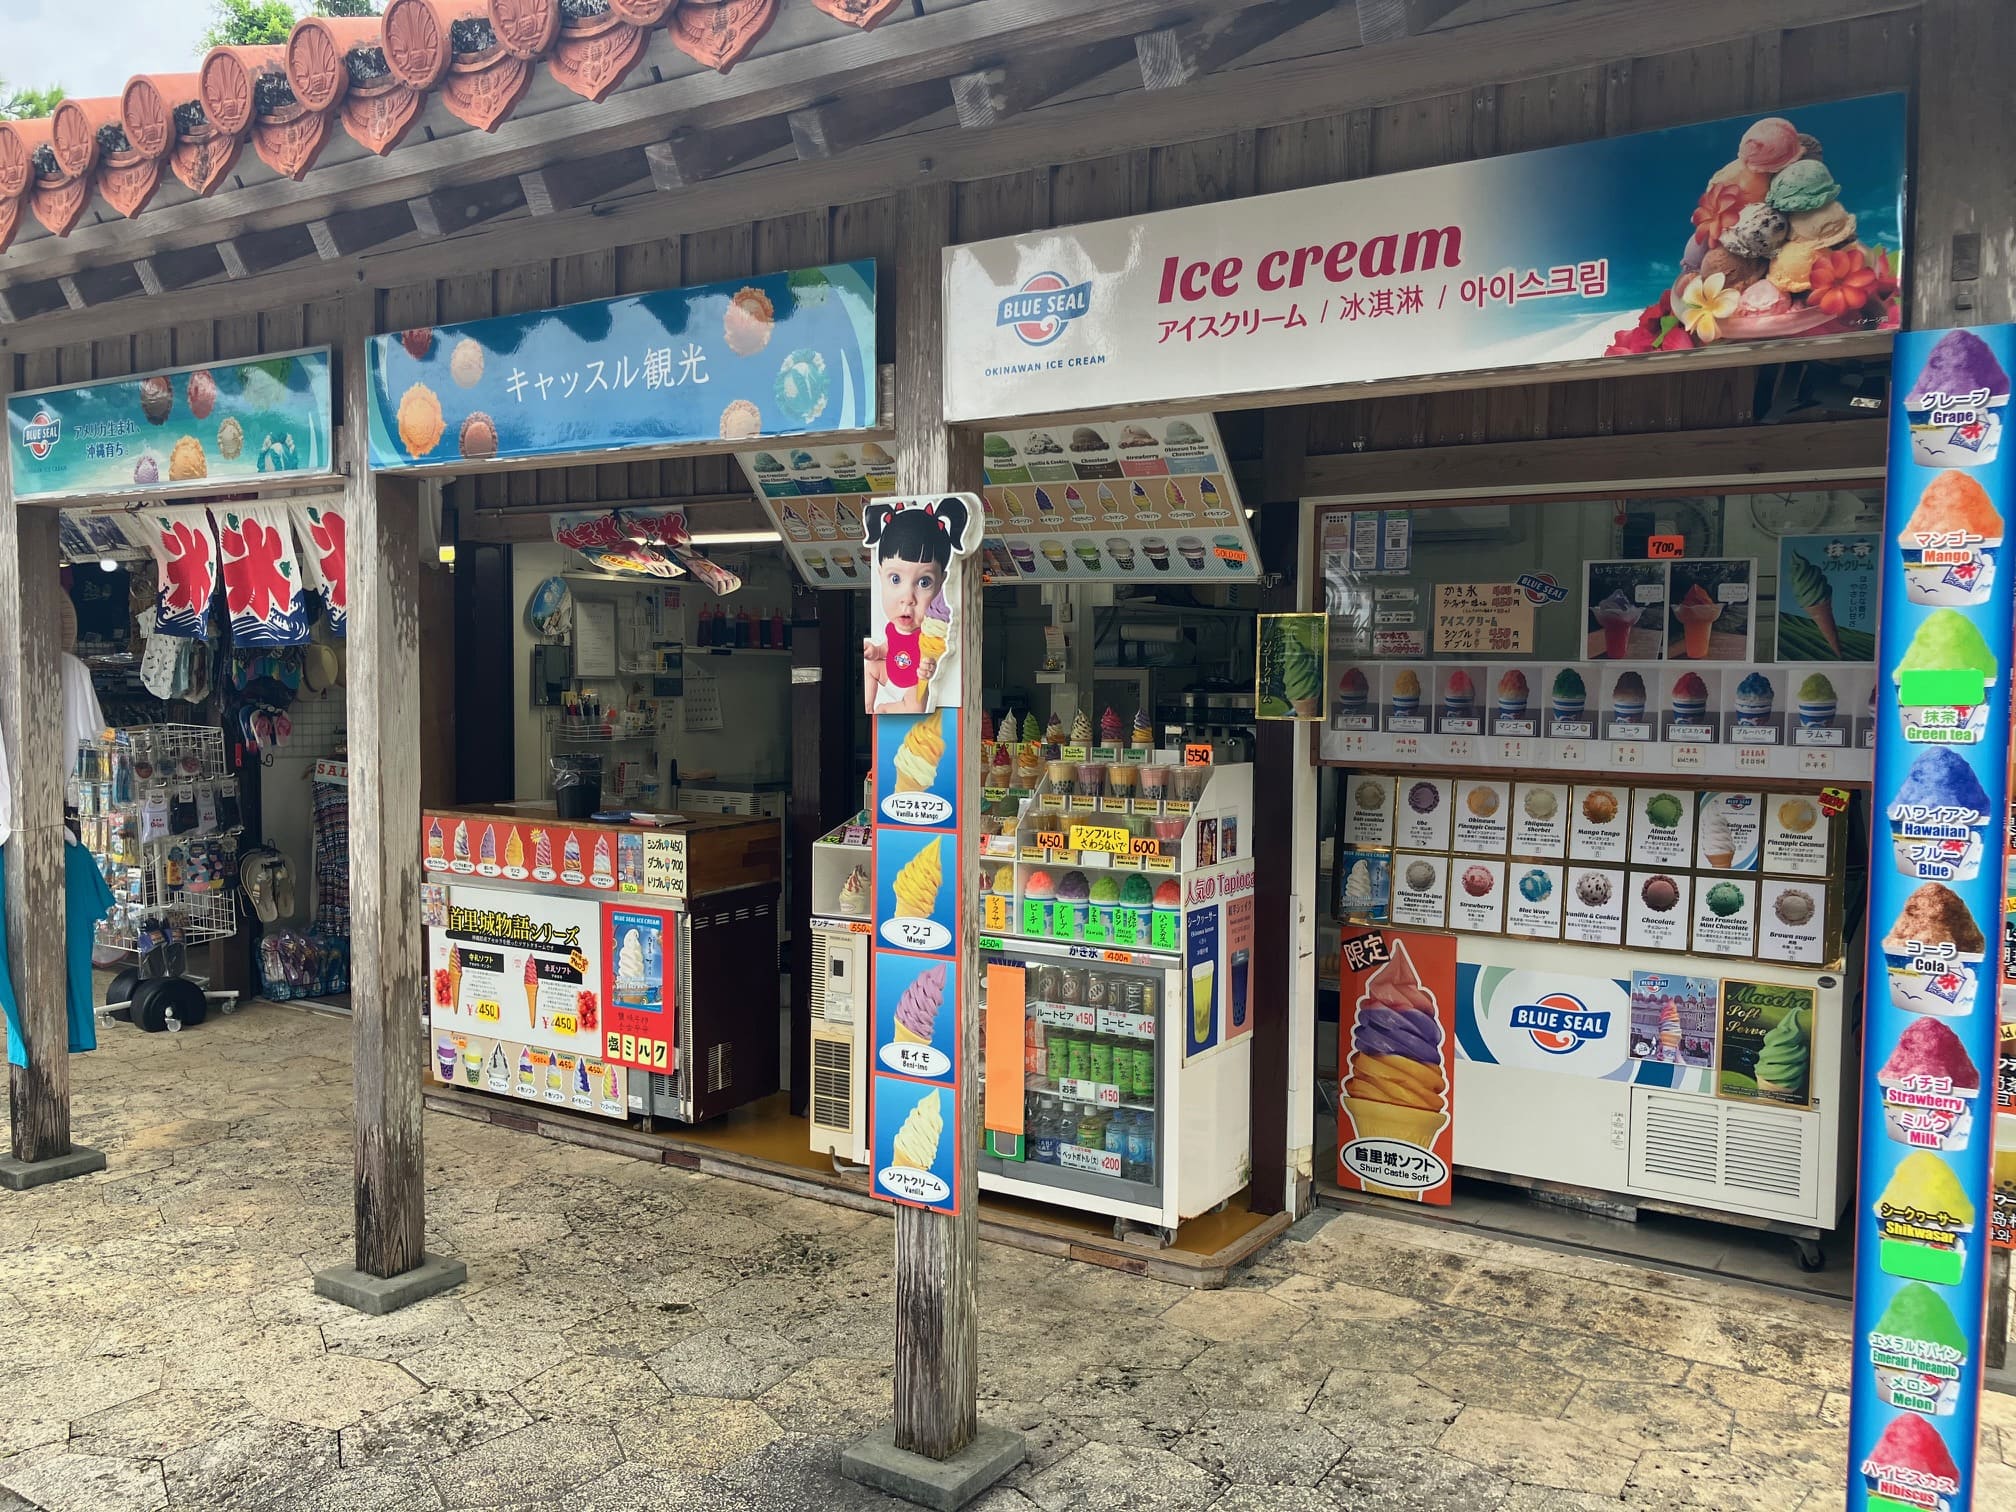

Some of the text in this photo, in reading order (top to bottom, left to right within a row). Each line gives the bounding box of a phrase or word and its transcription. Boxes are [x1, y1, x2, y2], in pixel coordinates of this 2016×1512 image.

[1158, 225, 1462, 304] Ice cream
[1003, 290, 1086, 319] BLUE SEAL
[1157, 303, 1307, 344] アイスクリーム
[1339, 284, 1424, 321] 冰淇淋
[1459, 260, 1608, 308] 아이스크림
[505, 342, 710, 403] キャッスル観光
[984, 355, 1106, 377] OKINAWAN ICE CREAM
[1921, 389, 1990, 409] グレープ
[1933, 410, 1974, 426] Grape
[26, 427, 58, 441] BLUE SEAL
[1914, 531, 1983, 548] マンゴー
[1215, 549, 1247, 561] SOLD OUT
[1924, 550, 1971, 564] Mango
[1521, 577, 1563, 599] BLUE SEAL
[1923, 709, 1957, 725] 抹茶
[1555, 724, 1579, 732] メロン
[1806, 730, 1833, 739] ラムネ
[1907, 726, 1973, 742] Green tea
[316, 762, 349, 778] SAL
[895, 810, 915, 818] Vanilla
[920, 812, 939, 820] Mango
[1895, 805, 1979, 823] ハワイアン
[1075, 828, 1121, 839] サンプルに
[1650, 828, 1676, 836] Almond
[1904, 823, 1967, 838] Hawaiian
[647, 838, 664, 850] シングル
[1080, 839, 1128, 852] さわらないで
[1911, 846, 1959, 860] ブルー
[647, 857, 664, 869] ダブル
[1918, 863, 1950, 877] Blue
[647, 876, 664, 889] トリプル
[1459, 901, 1494, 910] Strawberry
[450, 906, 580, 946] 首里城物語シリーズ
[1641, 917, 1676, 926] Chocolate
[1714, 917, 1748, 925] Francisco
[1716, 923, 1749, 931] Chocolate
[902, 923, 932, 937] マンゴ
[1794, 934, 1817, 942] sugar
[906, 935, 926, 945] Mango
[1068, 946, 1099, 959] かき氷
[1344, 934, 1390, 970] 限定
[1906, 941, 1956, 957] コーラ
[1915, 958, 1945, 973] Cola
[1726, 985, 1810, 1010] Maccha
[1037, 1009, 1094, 1026] ルートビア ¥150
[1102, 1017, 1133, 1028] コーヒー
[1517, 1009, 1604, 1034] BLUE SEAL
[1726, 1004, 1762, 1025] Soft
[1725, 1020, 1767, 1037] Serve
[607, 1035, 666, 1069] 塩ミルク
[900, 1049, 930, 1063] 紅イモ
[1902, 1075, 1951, 1093] イチゴ
[1100, 1089, 1118, 1103] ¥150
[1888, 1089, 1963, 1111] Strawberry
[1902, 1112, 1949, 1131] ミルク
[1909, 1130, 1938, 1146] Milk
[1101, 1156, 1120, 1171] ¥200
[1354, 1146, 1436, 1173] 首里城ソフト
[888, 1171, 942, 1191] ソフトクリーム
[1359, 1163, 1430, 1183] Shuri Castle Soft
[904, 1185, 924, 1196] Vanilla
[1885, 1221, 1957, 1246] Shikwasar
[1872, 1350, 1958, 1378] Emerald Pineapple
[1891, 1377, 1938, 1395] メロン
[1892, 1392, 1934, 1412] Melon
[1863, 1462, 1956, 1494] ハイビスカス
